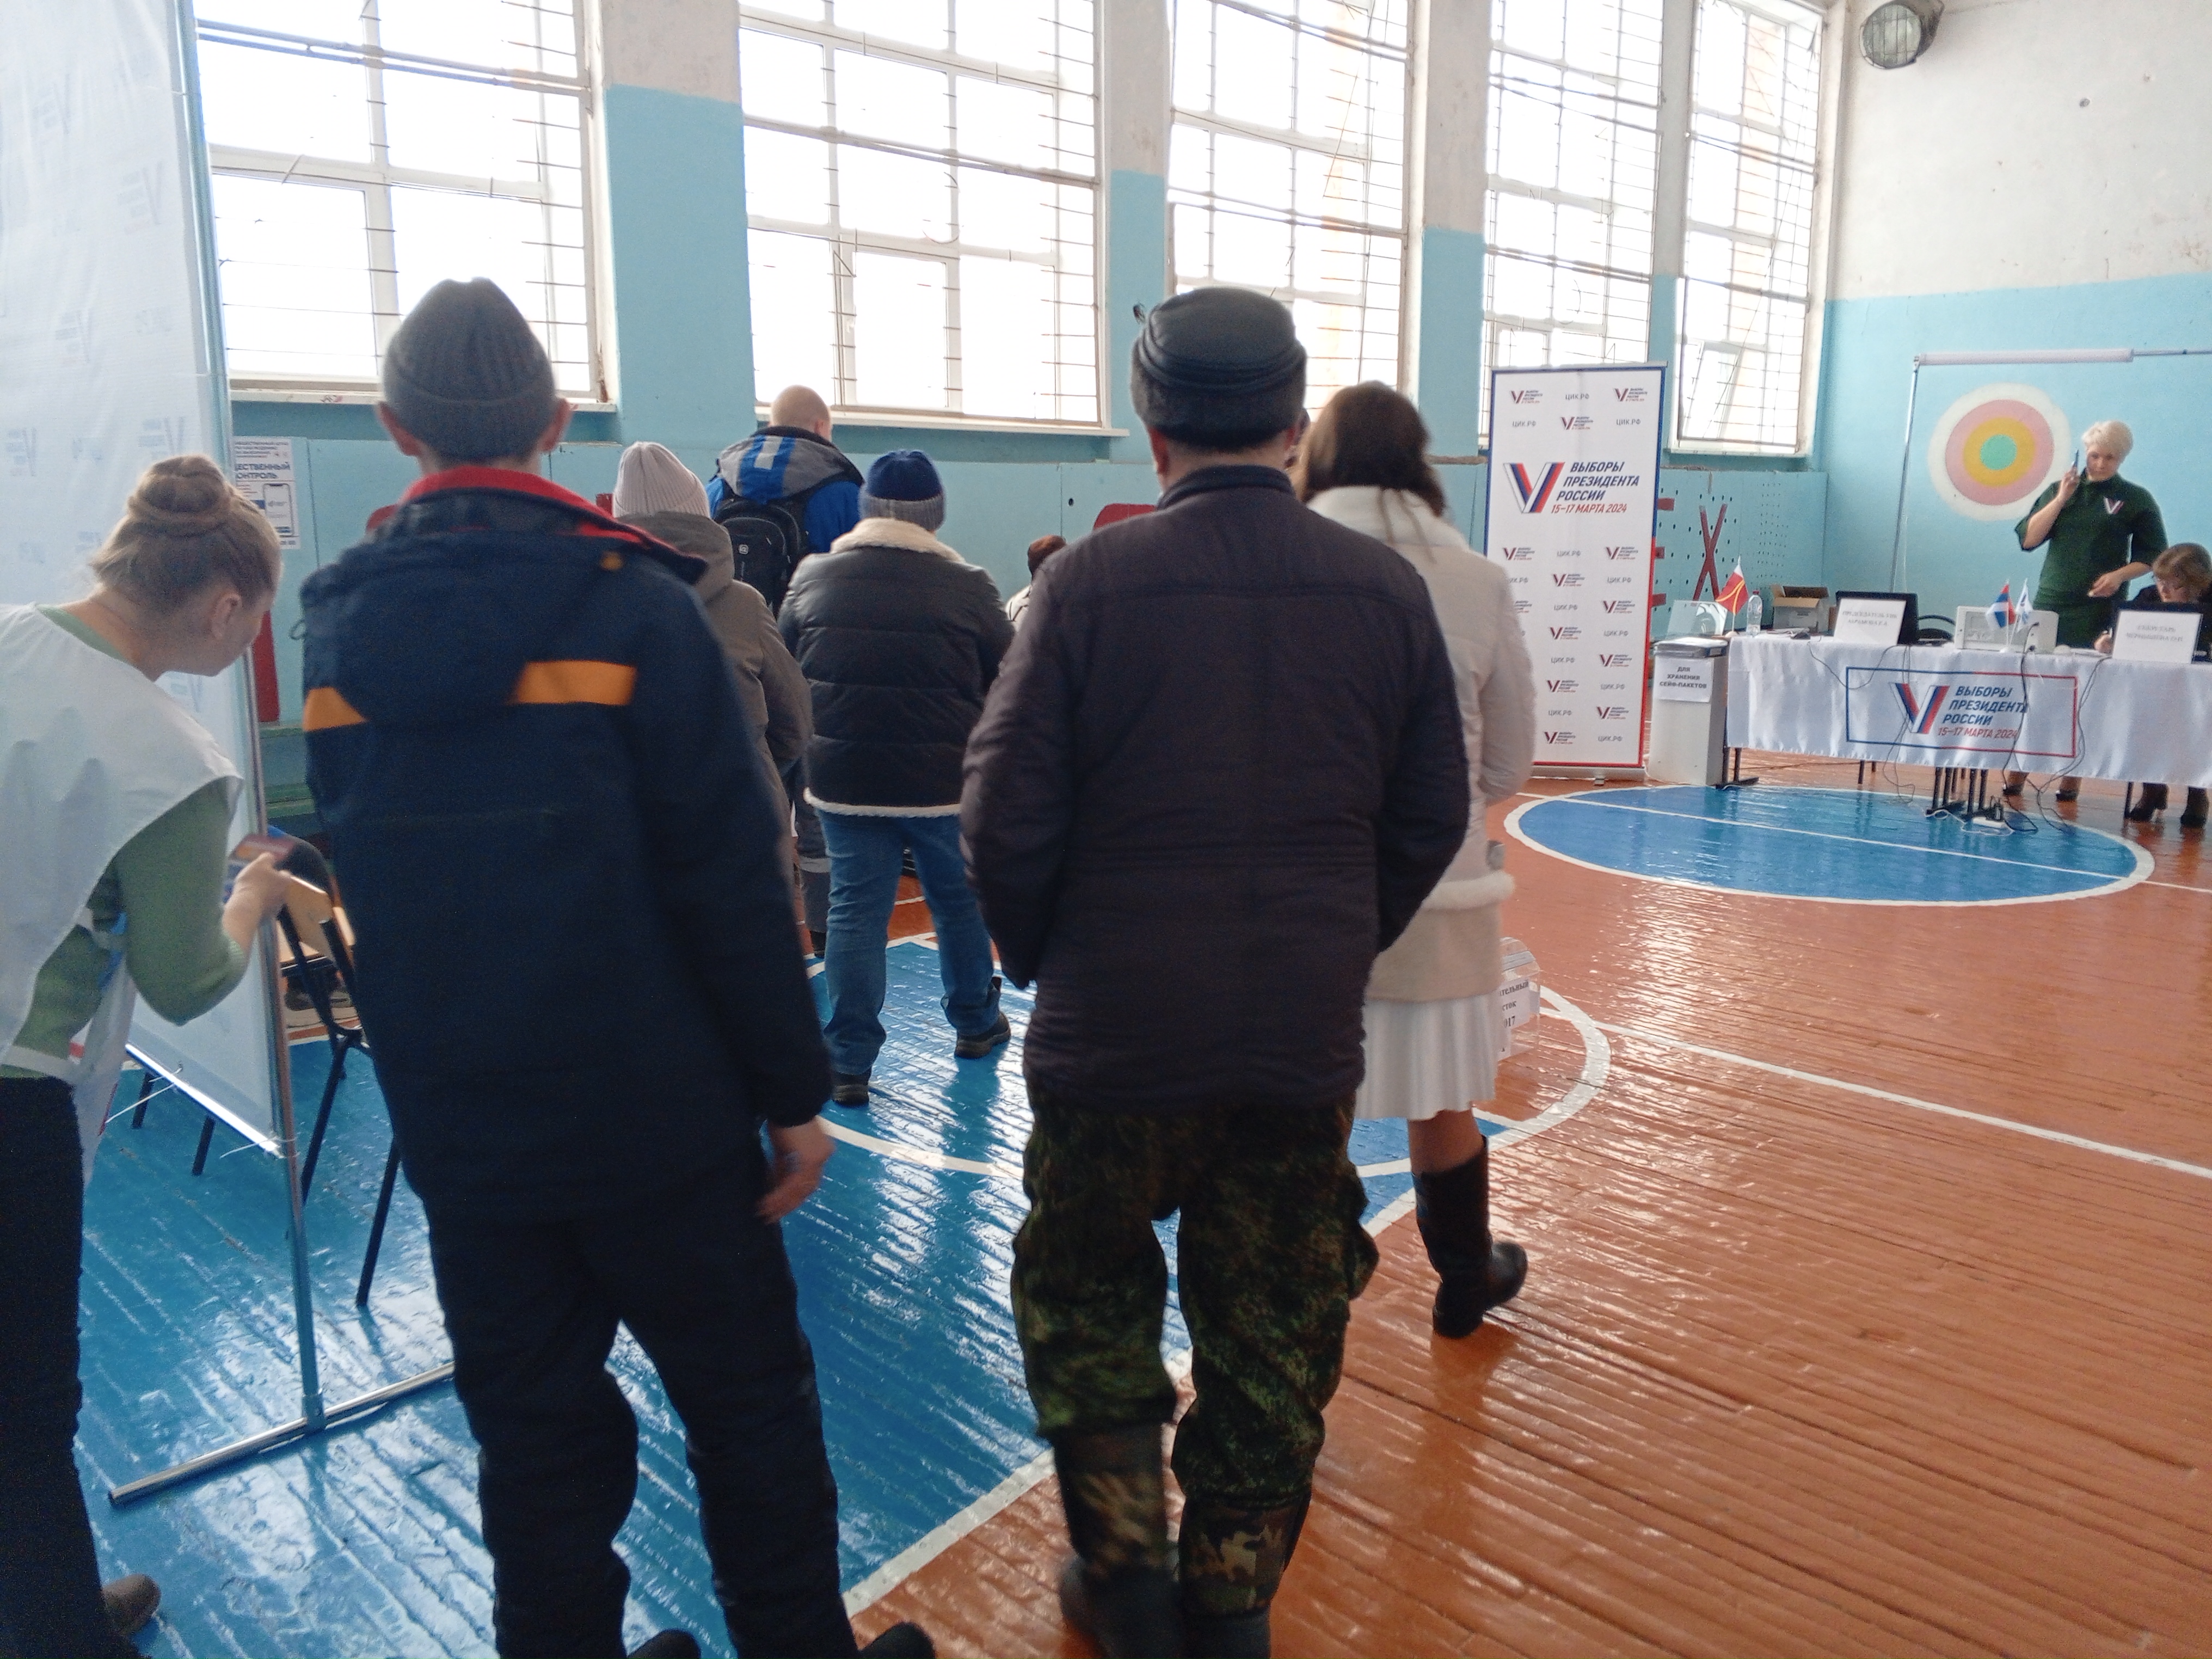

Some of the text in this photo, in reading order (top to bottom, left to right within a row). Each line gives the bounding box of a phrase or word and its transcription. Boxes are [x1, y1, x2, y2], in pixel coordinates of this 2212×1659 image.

[1570, 462, 1625, 472] ВЫБОРЫ
[1563, 475, 1640, 488] ПРЕЗИДЕНТА
[1556, 490, 1606, 501] РОССИИ
[1575, 503, 1605, 513] МАРТА
[1606, 503, 1627, 513] 2024
[1660, 680, 1707, 689] СЕЙФ-ПАКЕТОВ
[1956, 686, 2013, 697] ВЫБОРЫ
[1943, 714, 1993, 725] РОССИИ
[1964, 728, 1993, 738] МАРТА
